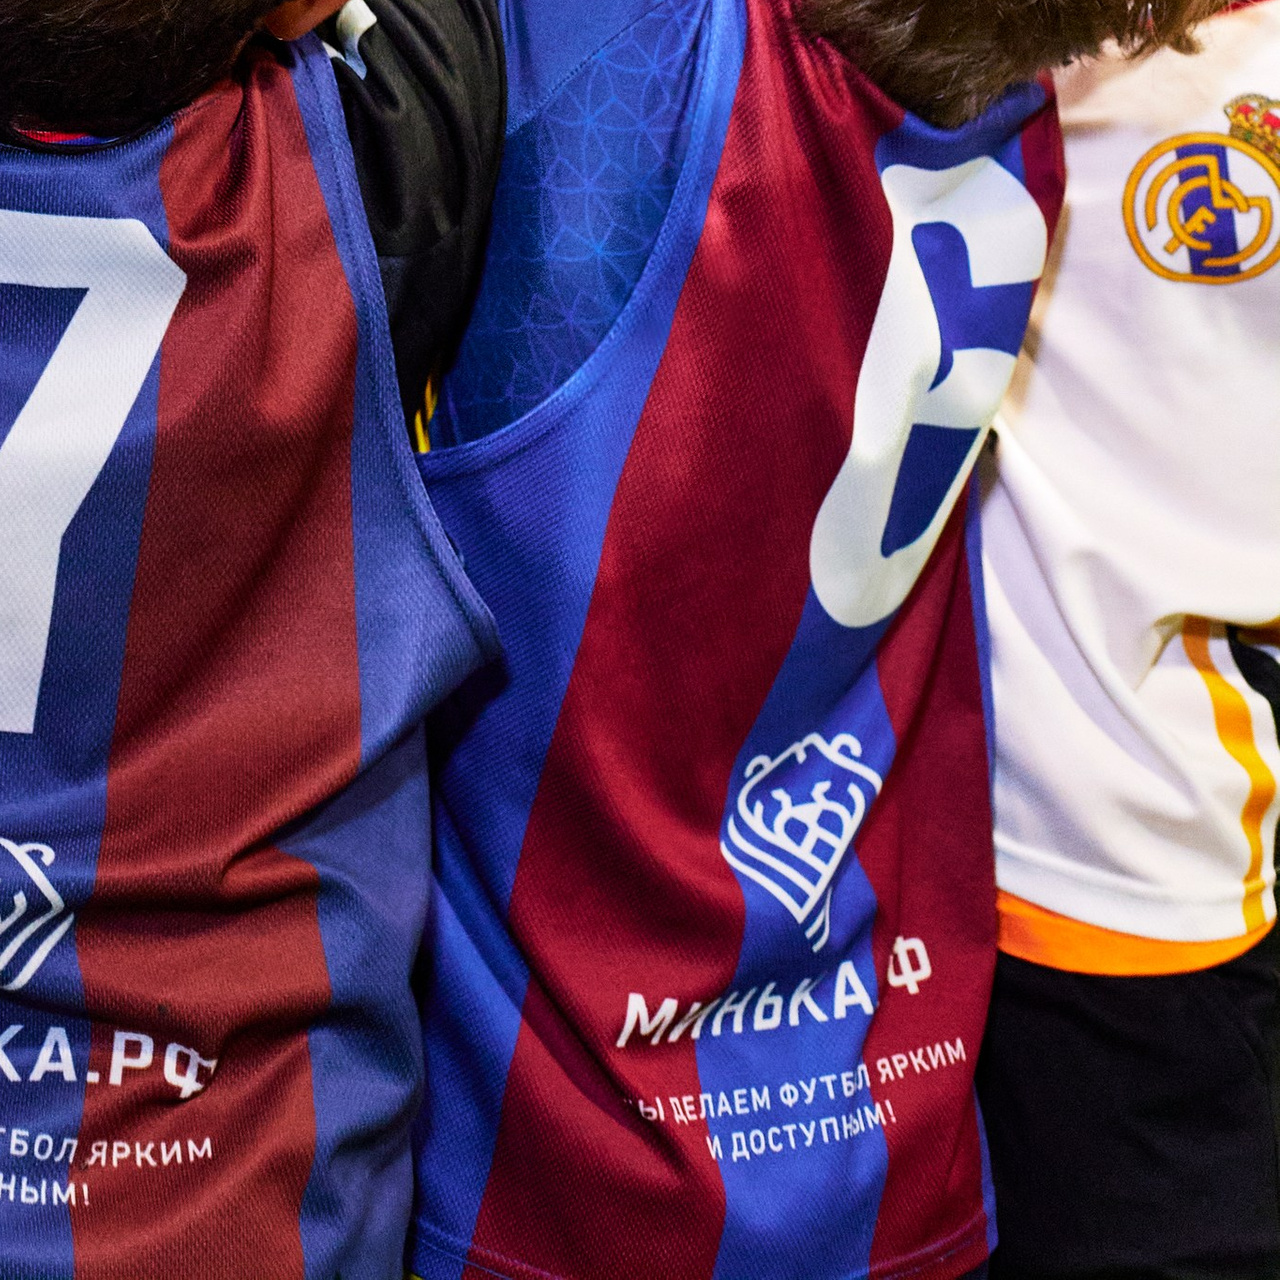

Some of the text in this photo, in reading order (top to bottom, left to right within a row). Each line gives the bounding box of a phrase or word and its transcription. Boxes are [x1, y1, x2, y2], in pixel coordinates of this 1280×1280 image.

[809, 155, 1048, 628] 6
[669, 1085, 771, 1125] ДЕЛАЕМ
[876, 1037, 967, 1084] ЯРКИМ
[89, 1137, 214, 1168] ЯРКИМ
[706, 1134, 723, 1161] И
